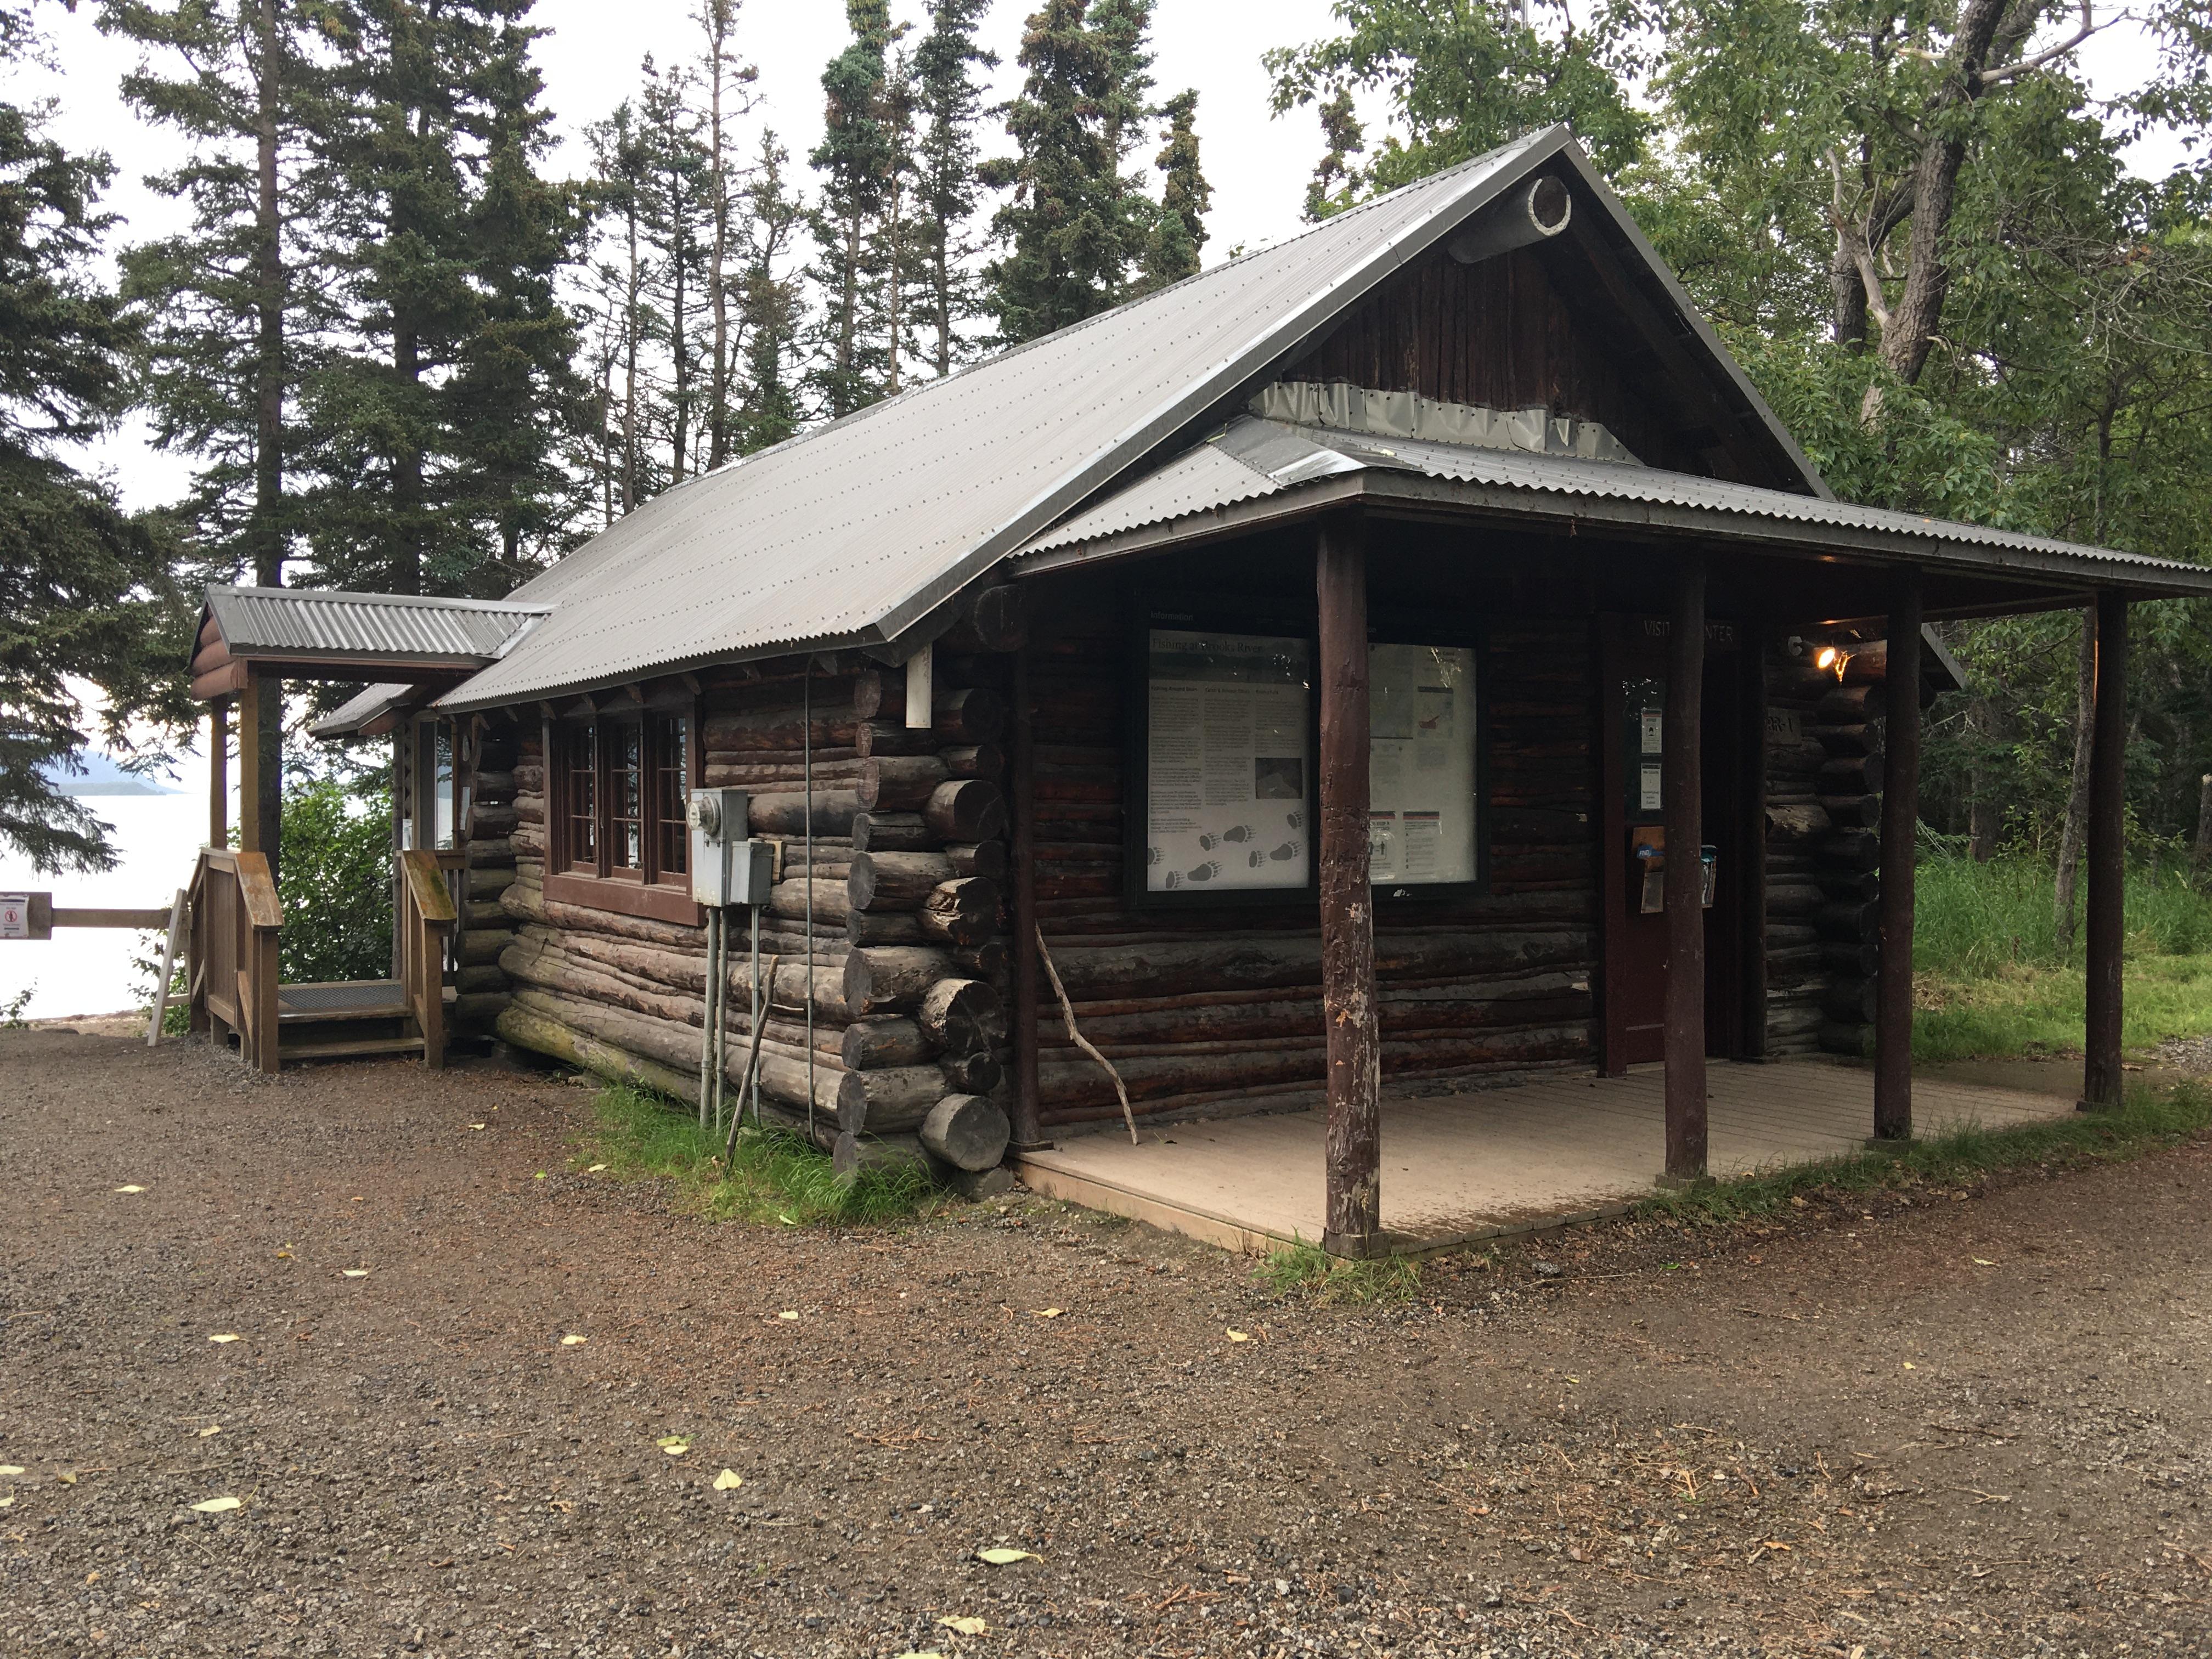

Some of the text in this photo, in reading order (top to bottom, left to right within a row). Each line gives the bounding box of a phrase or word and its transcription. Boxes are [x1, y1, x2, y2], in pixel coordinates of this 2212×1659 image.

[1150, 610, 1194, 621] Information
[1644, 619, 1733, 641] VISIT NTER
[1152, 638, 1263, 653] Fishing at Brooks River
